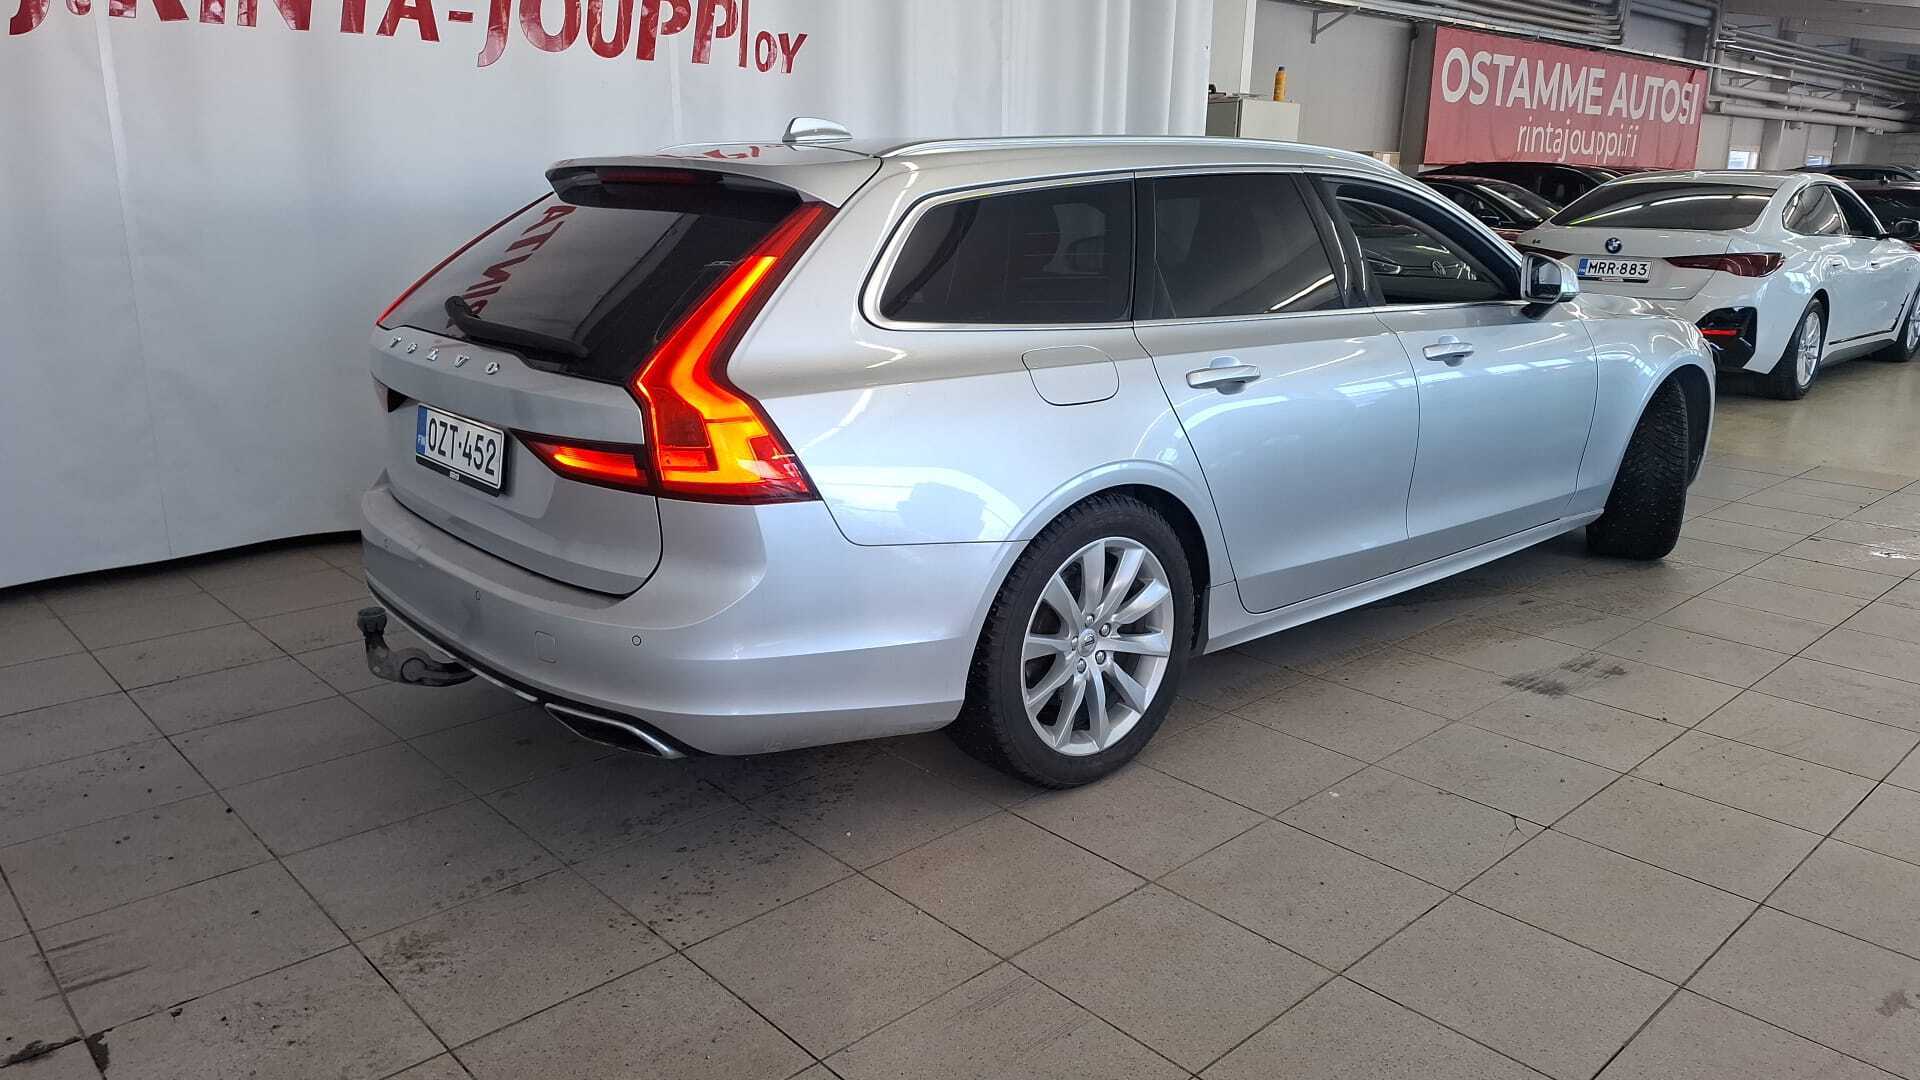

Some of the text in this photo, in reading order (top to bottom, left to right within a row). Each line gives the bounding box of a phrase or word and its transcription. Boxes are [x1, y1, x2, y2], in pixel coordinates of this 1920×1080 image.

[755, 31, 808, 73] OY
[1441, 47, 1701, 124] OSTAMME AUTOSI
[1517, 117, 1640, 163] rintajouppi.fi
[1588, 261, 1648, 276] MRR-883
[390, 336, 500, 375] VOLVO
[428, 417, 497, 477] OZT-452
